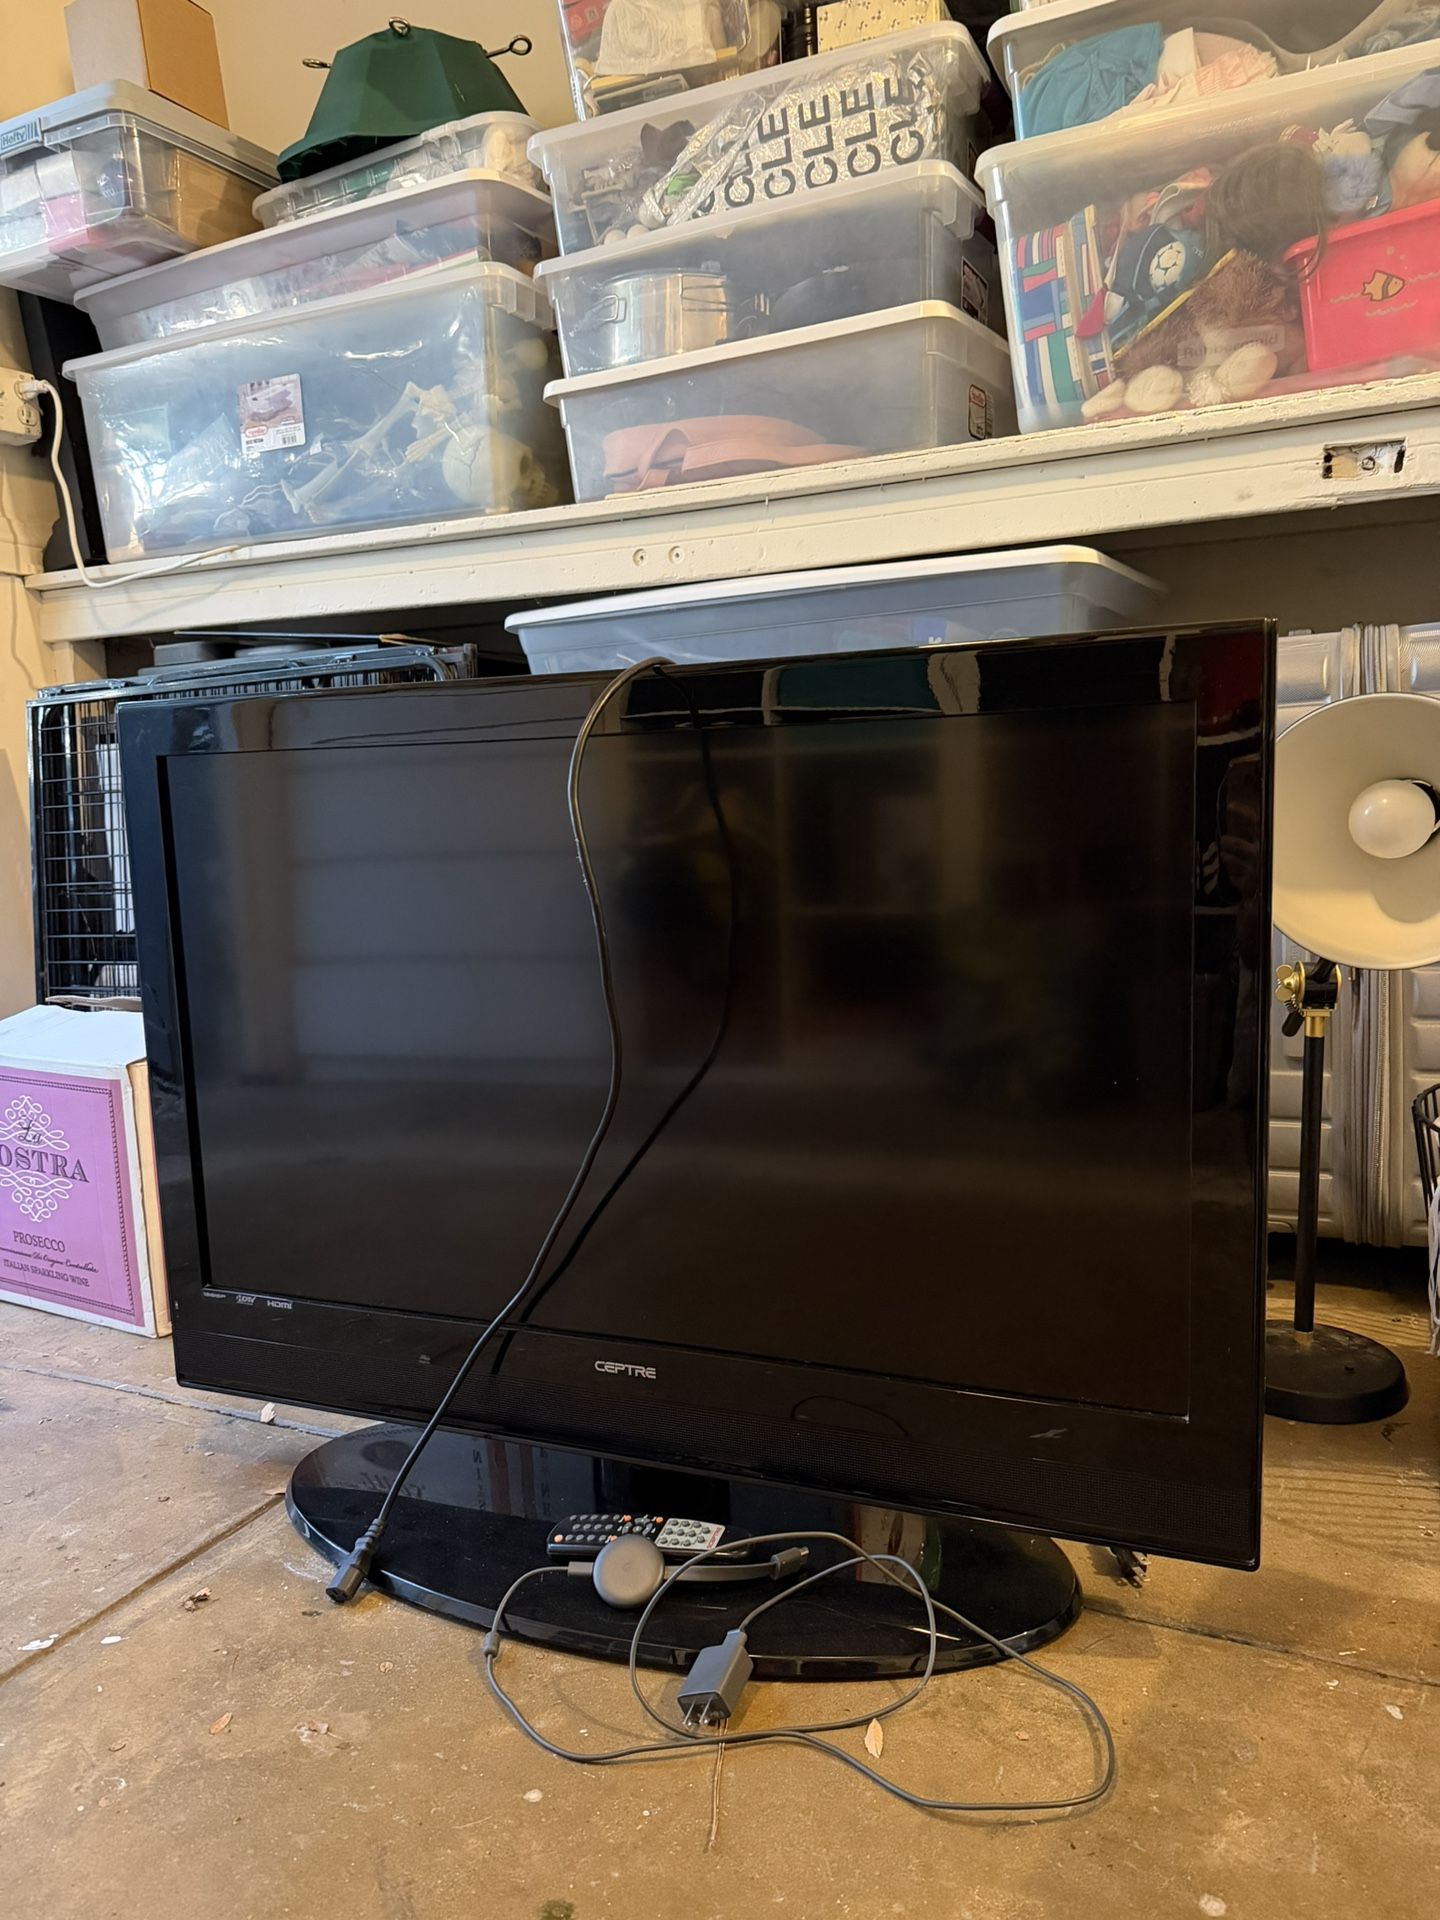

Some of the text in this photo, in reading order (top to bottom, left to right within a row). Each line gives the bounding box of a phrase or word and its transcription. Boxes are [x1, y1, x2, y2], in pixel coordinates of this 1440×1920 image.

[798, 94, 838, 188] CLE
[840, 82, 881, 178] CLE
[13, 1230, 66, 1253] PROSECCO
[3, 1258, 90, 1288] ITALIAN SPARKLING WINE
[594, 1360, 657, 1380] CEPTRE
